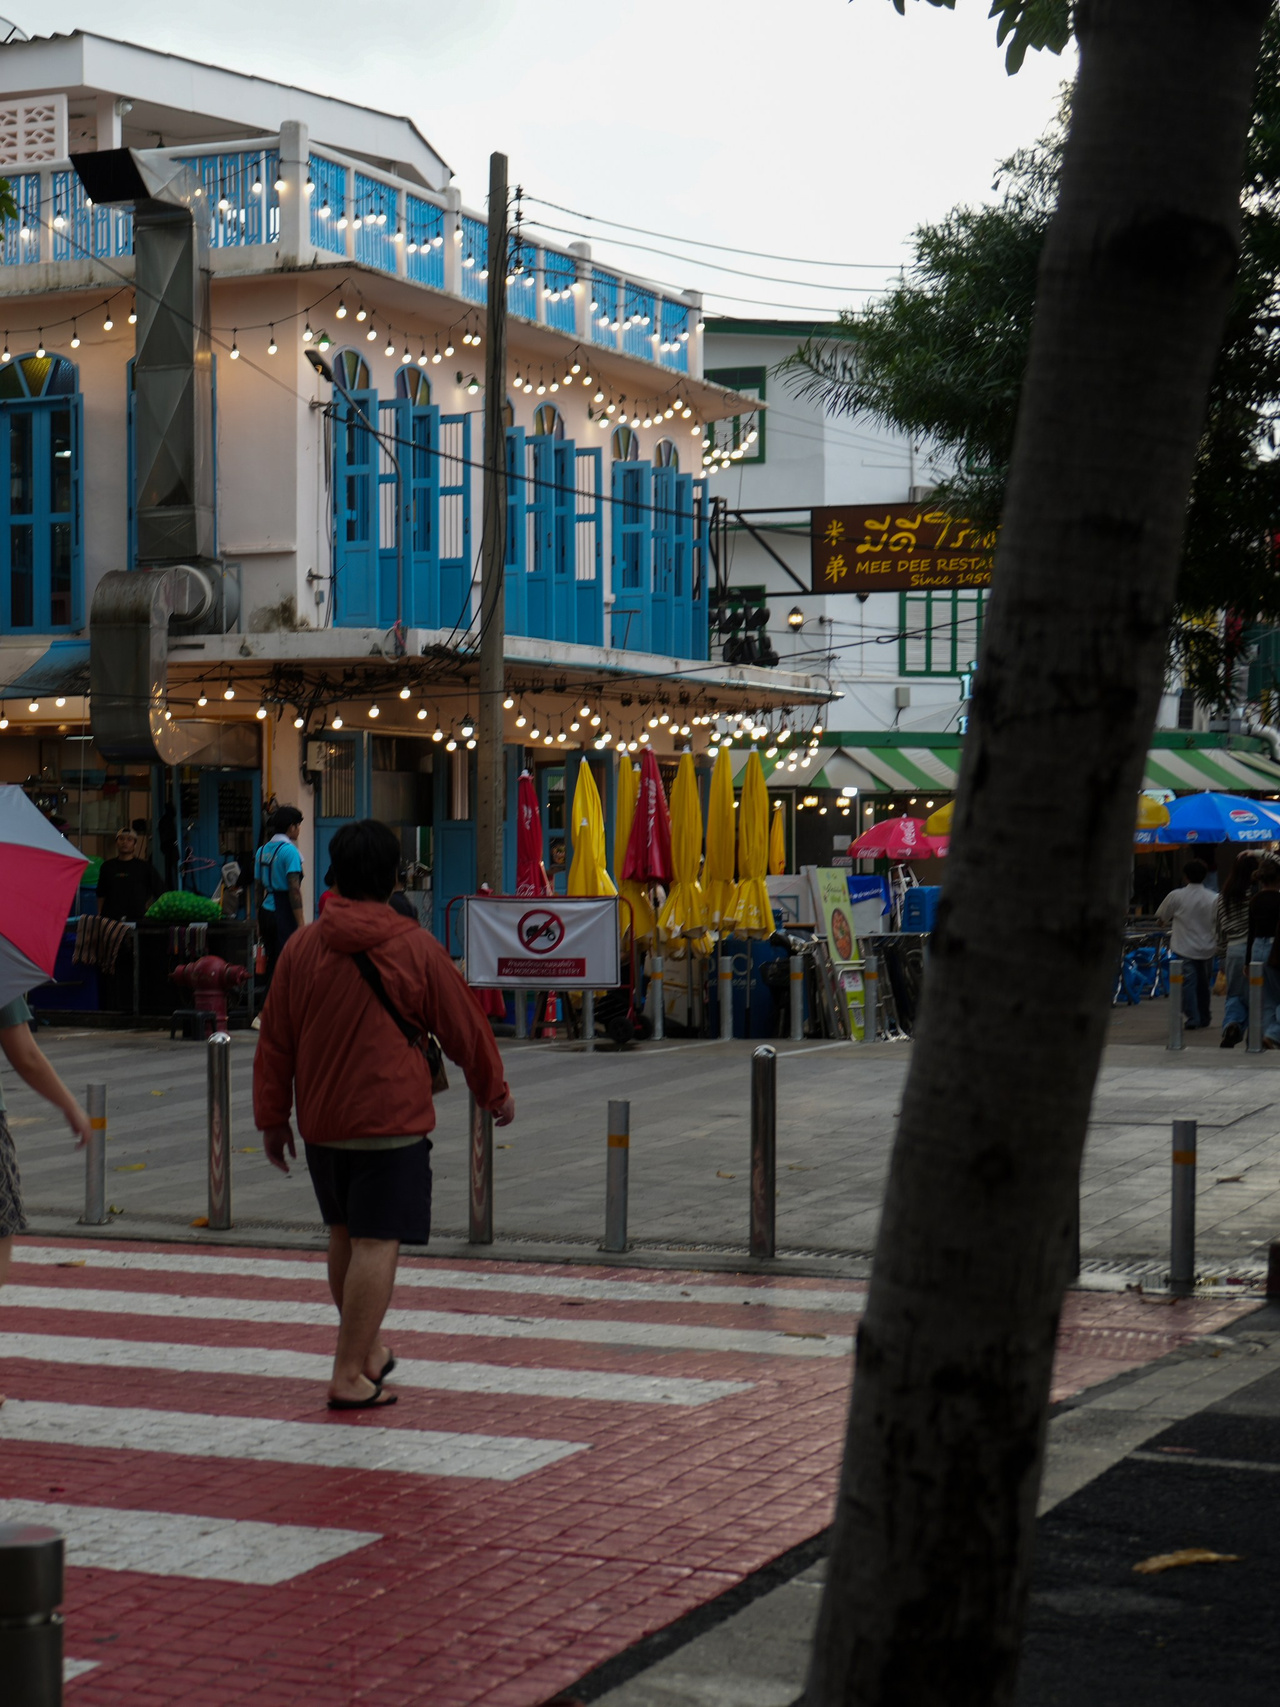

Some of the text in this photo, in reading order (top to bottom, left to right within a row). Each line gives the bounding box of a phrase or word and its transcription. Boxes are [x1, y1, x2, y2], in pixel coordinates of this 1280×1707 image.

[855, 560, 893, 575] MEE
[897, 558, 932, 573] DEE
[910, 571, 993, 587] Since 1959
[1238, 828, 1272, 840] PEPSI
[514, 967, 557, 975] MOTORCYCLE
[558, 967, 581, 975] ENTRY
